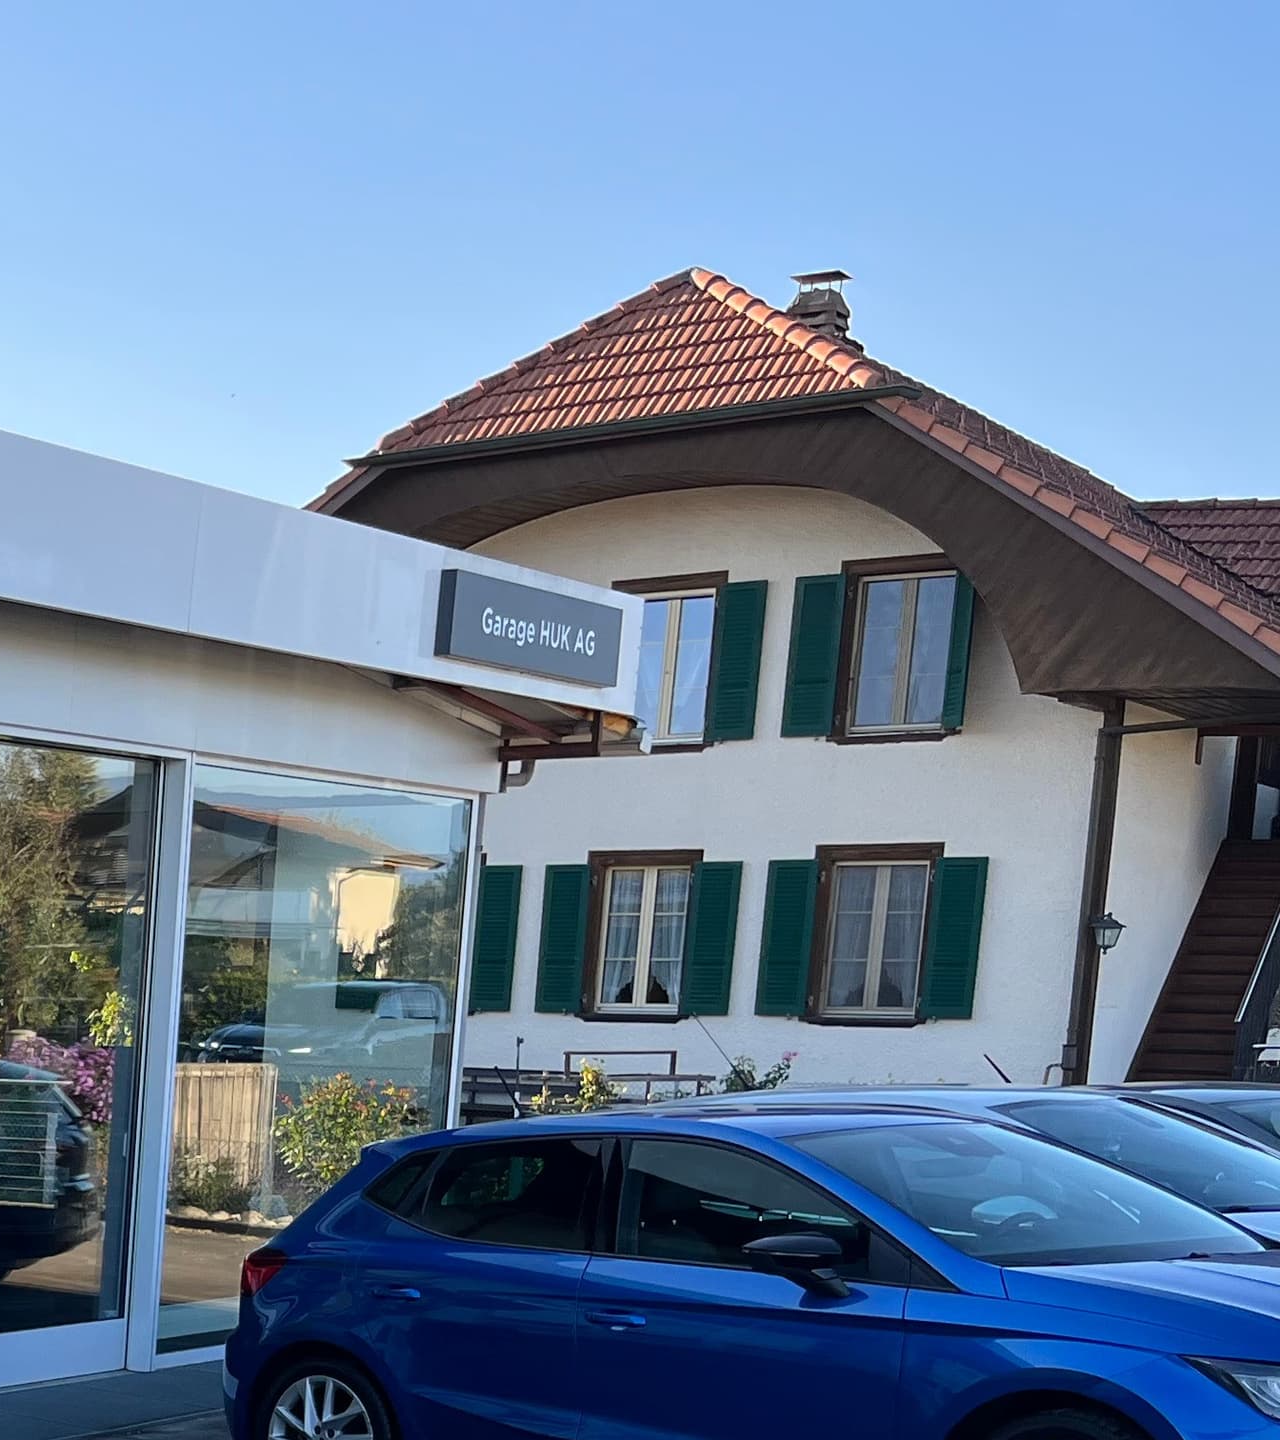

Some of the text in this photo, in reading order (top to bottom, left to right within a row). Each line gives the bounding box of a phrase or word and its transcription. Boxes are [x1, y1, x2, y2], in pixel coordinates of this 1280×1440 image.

[482, 607, 596, 656] Garage HUK AG
